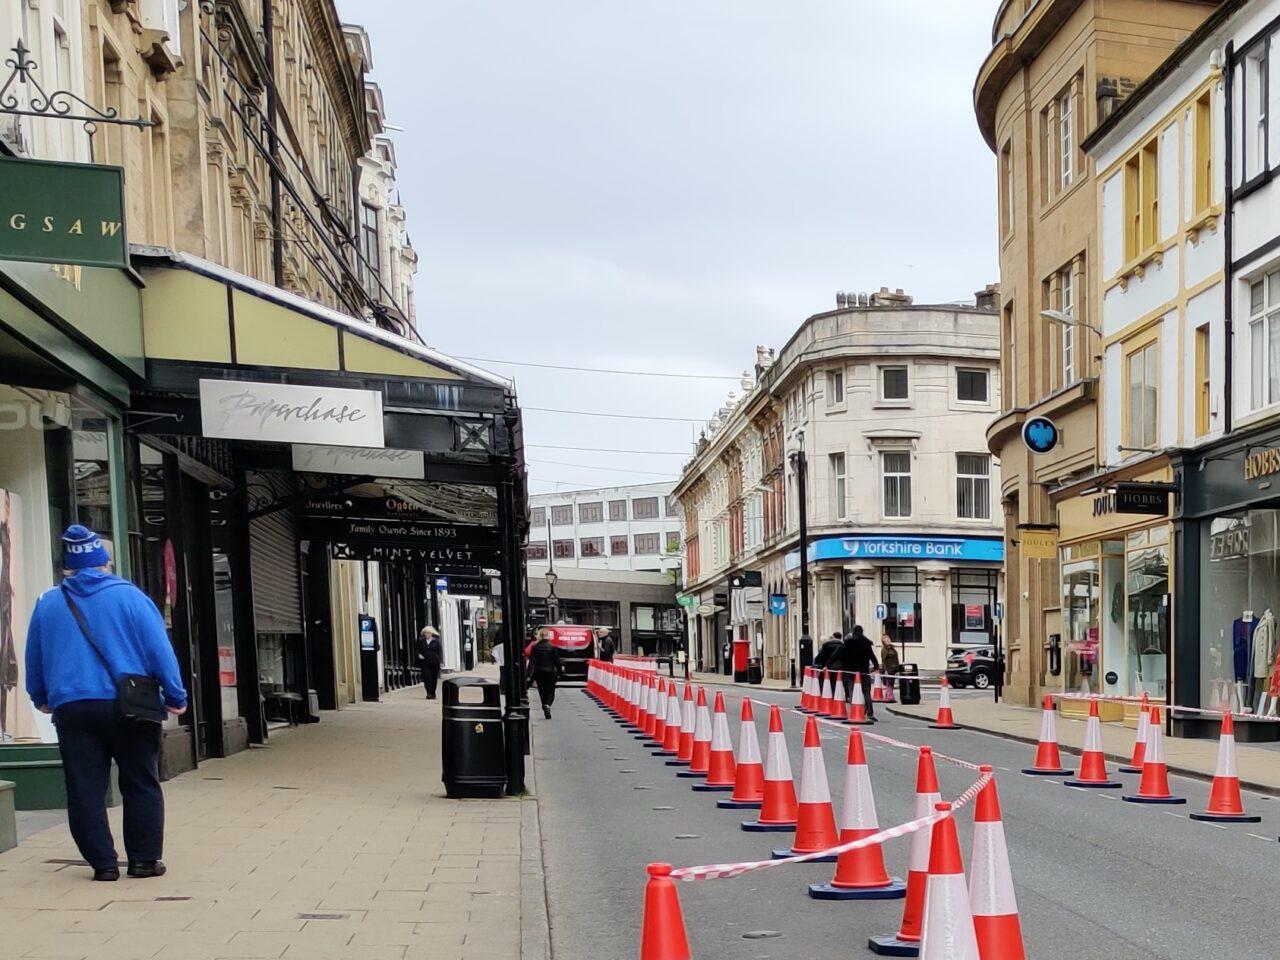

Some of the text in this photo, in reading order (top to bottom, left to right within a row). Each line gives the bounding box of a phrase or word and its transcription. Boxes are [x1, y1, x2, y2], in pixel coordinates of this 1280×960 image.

[218, 390, 366, 431] Paperchase
[1123, 493, 1162, 505] HOBBS
[1092, 494, 1117, 518] JOUL
[351, 524, 457, 538] Family Owned Since 1893
[863, 542, 963, 555] Yorkshire Bank
[1023, 539, 1055, 548] JOULES
[373, 547, 473, 560] MINT VELVET
